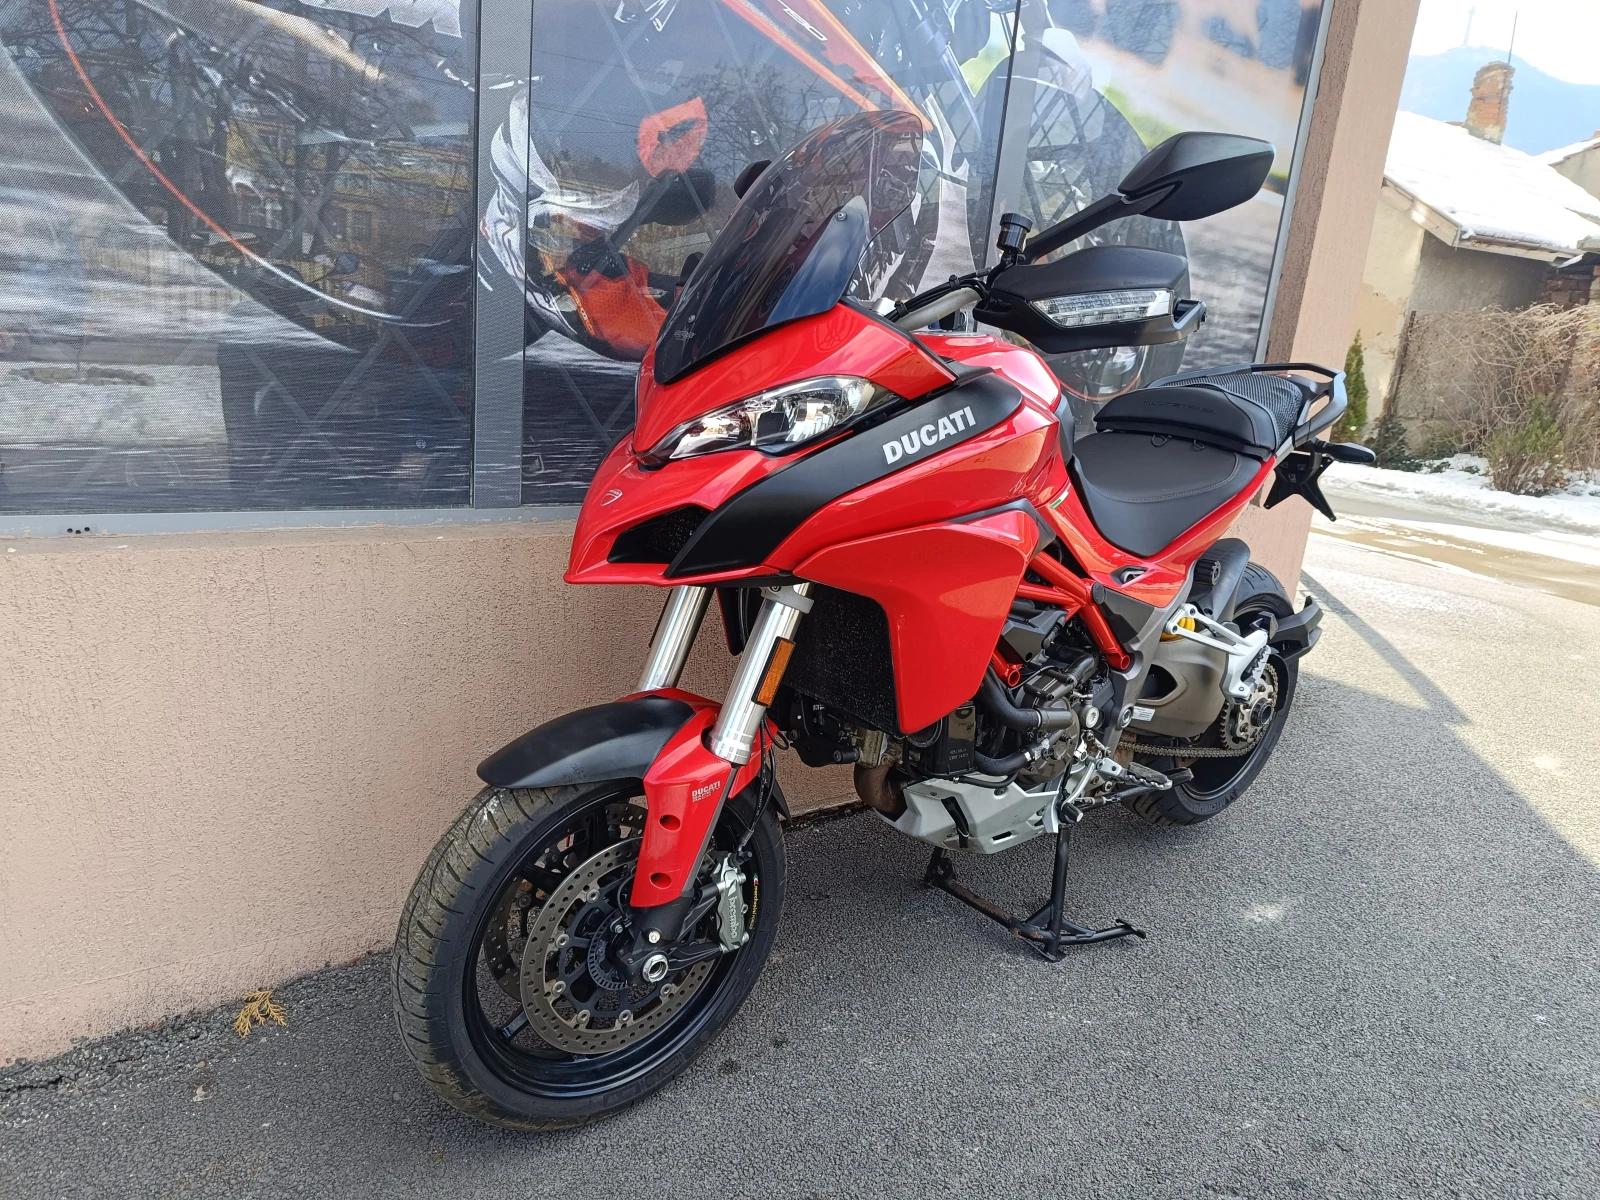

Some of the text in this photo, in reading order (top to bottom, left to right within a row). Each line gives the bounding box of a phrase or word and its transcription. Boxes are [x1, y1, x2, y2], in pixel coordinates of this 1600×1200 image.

[882, 405, 977, 465] DUCATI
[692, 781, 720, 797] DUCATI
[728, 896, 740, 939] brembo
